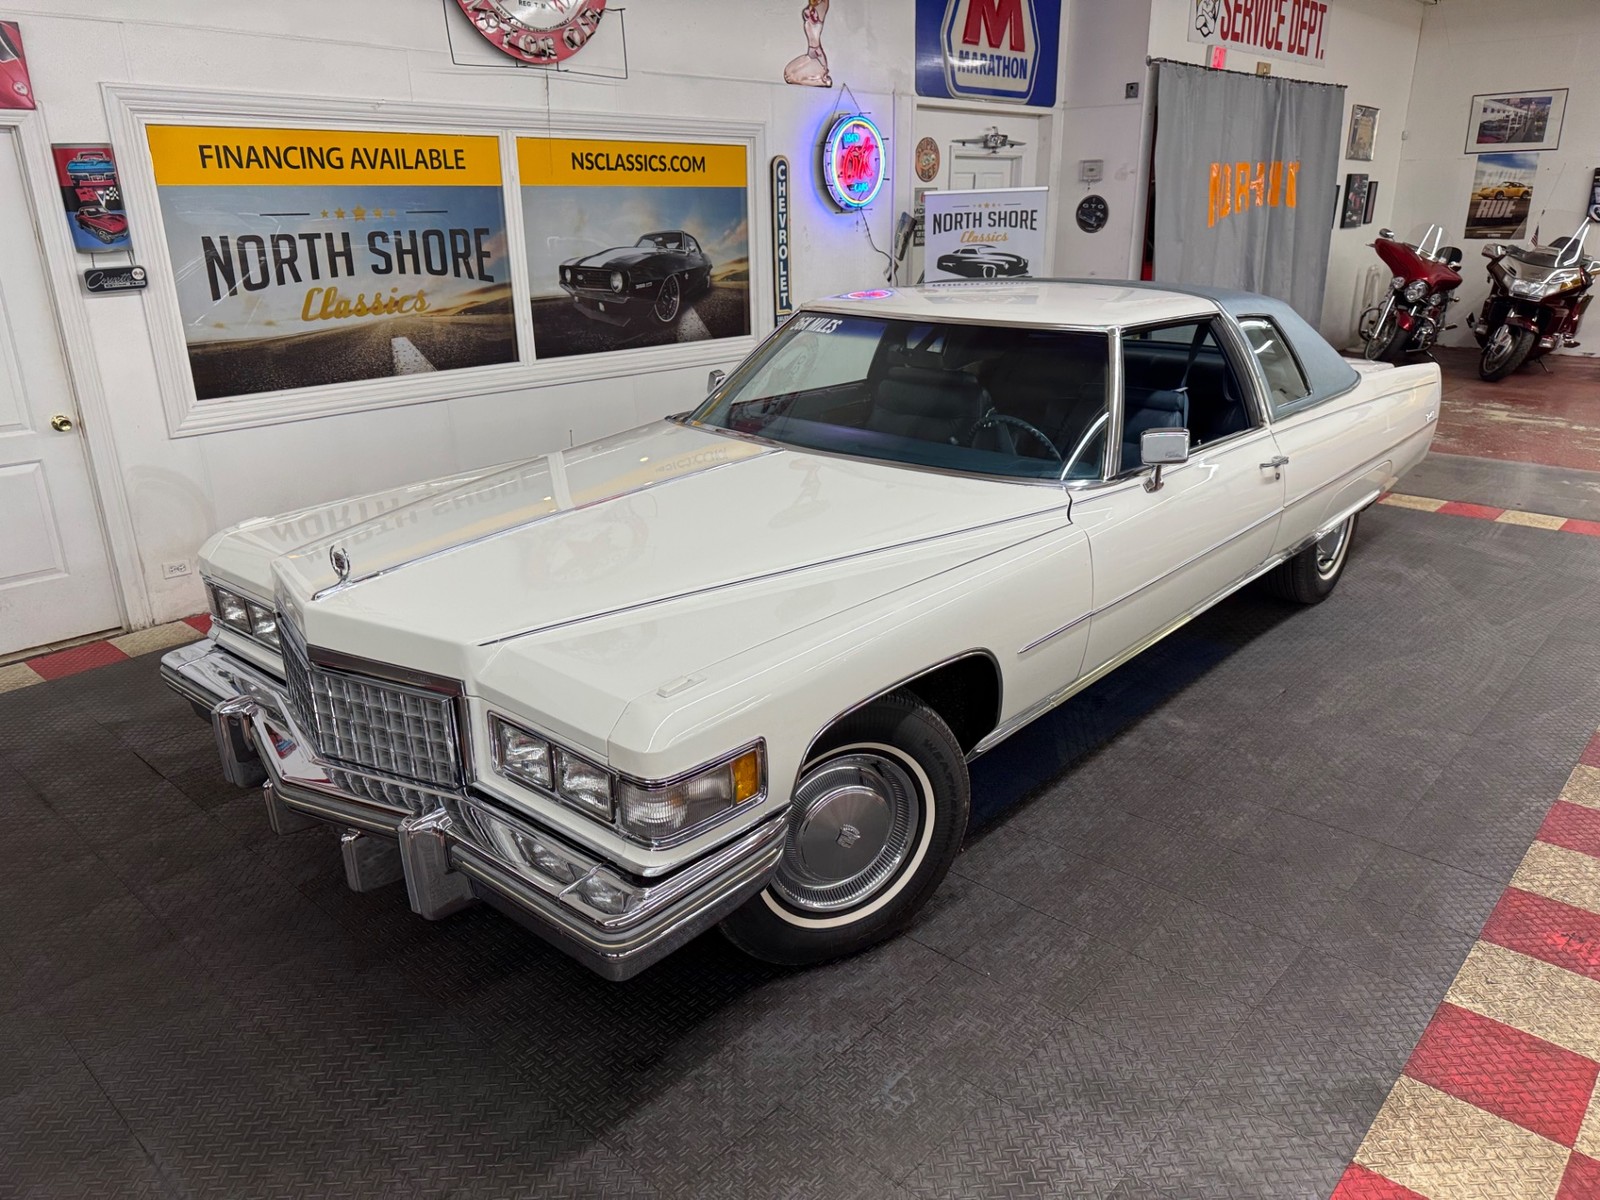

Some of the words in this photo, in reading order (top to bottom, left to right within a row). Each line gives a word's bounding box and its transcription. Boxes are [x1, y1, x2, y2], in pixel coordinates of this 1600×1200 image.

[962, 0, 1025, 53] M
[1220, 0, 1285, 51] SERVICE
[1287, 0, 1327, 60] DEPT.
[957, 50, 1027, 80] MARATHON
[199, 144, 344, 171] FINANCING
[350, 146, 466, 171] AVAILABLE
[571, 152, 706, 173] NSCLASSICS.COM
[932, 211, 982, 235] NORTH
[988, 209, 1038, 231] SHORE
[1475, 200, 1517, 218] RIDE
[776, 164, 789, 308] CHEVROLET
[960, 230, 1009, 243] Classics
[201, 231, 355, 302] NORTH
[368, 228, 495, 283] SHORE
[302, 286, 432, 322] Classics
